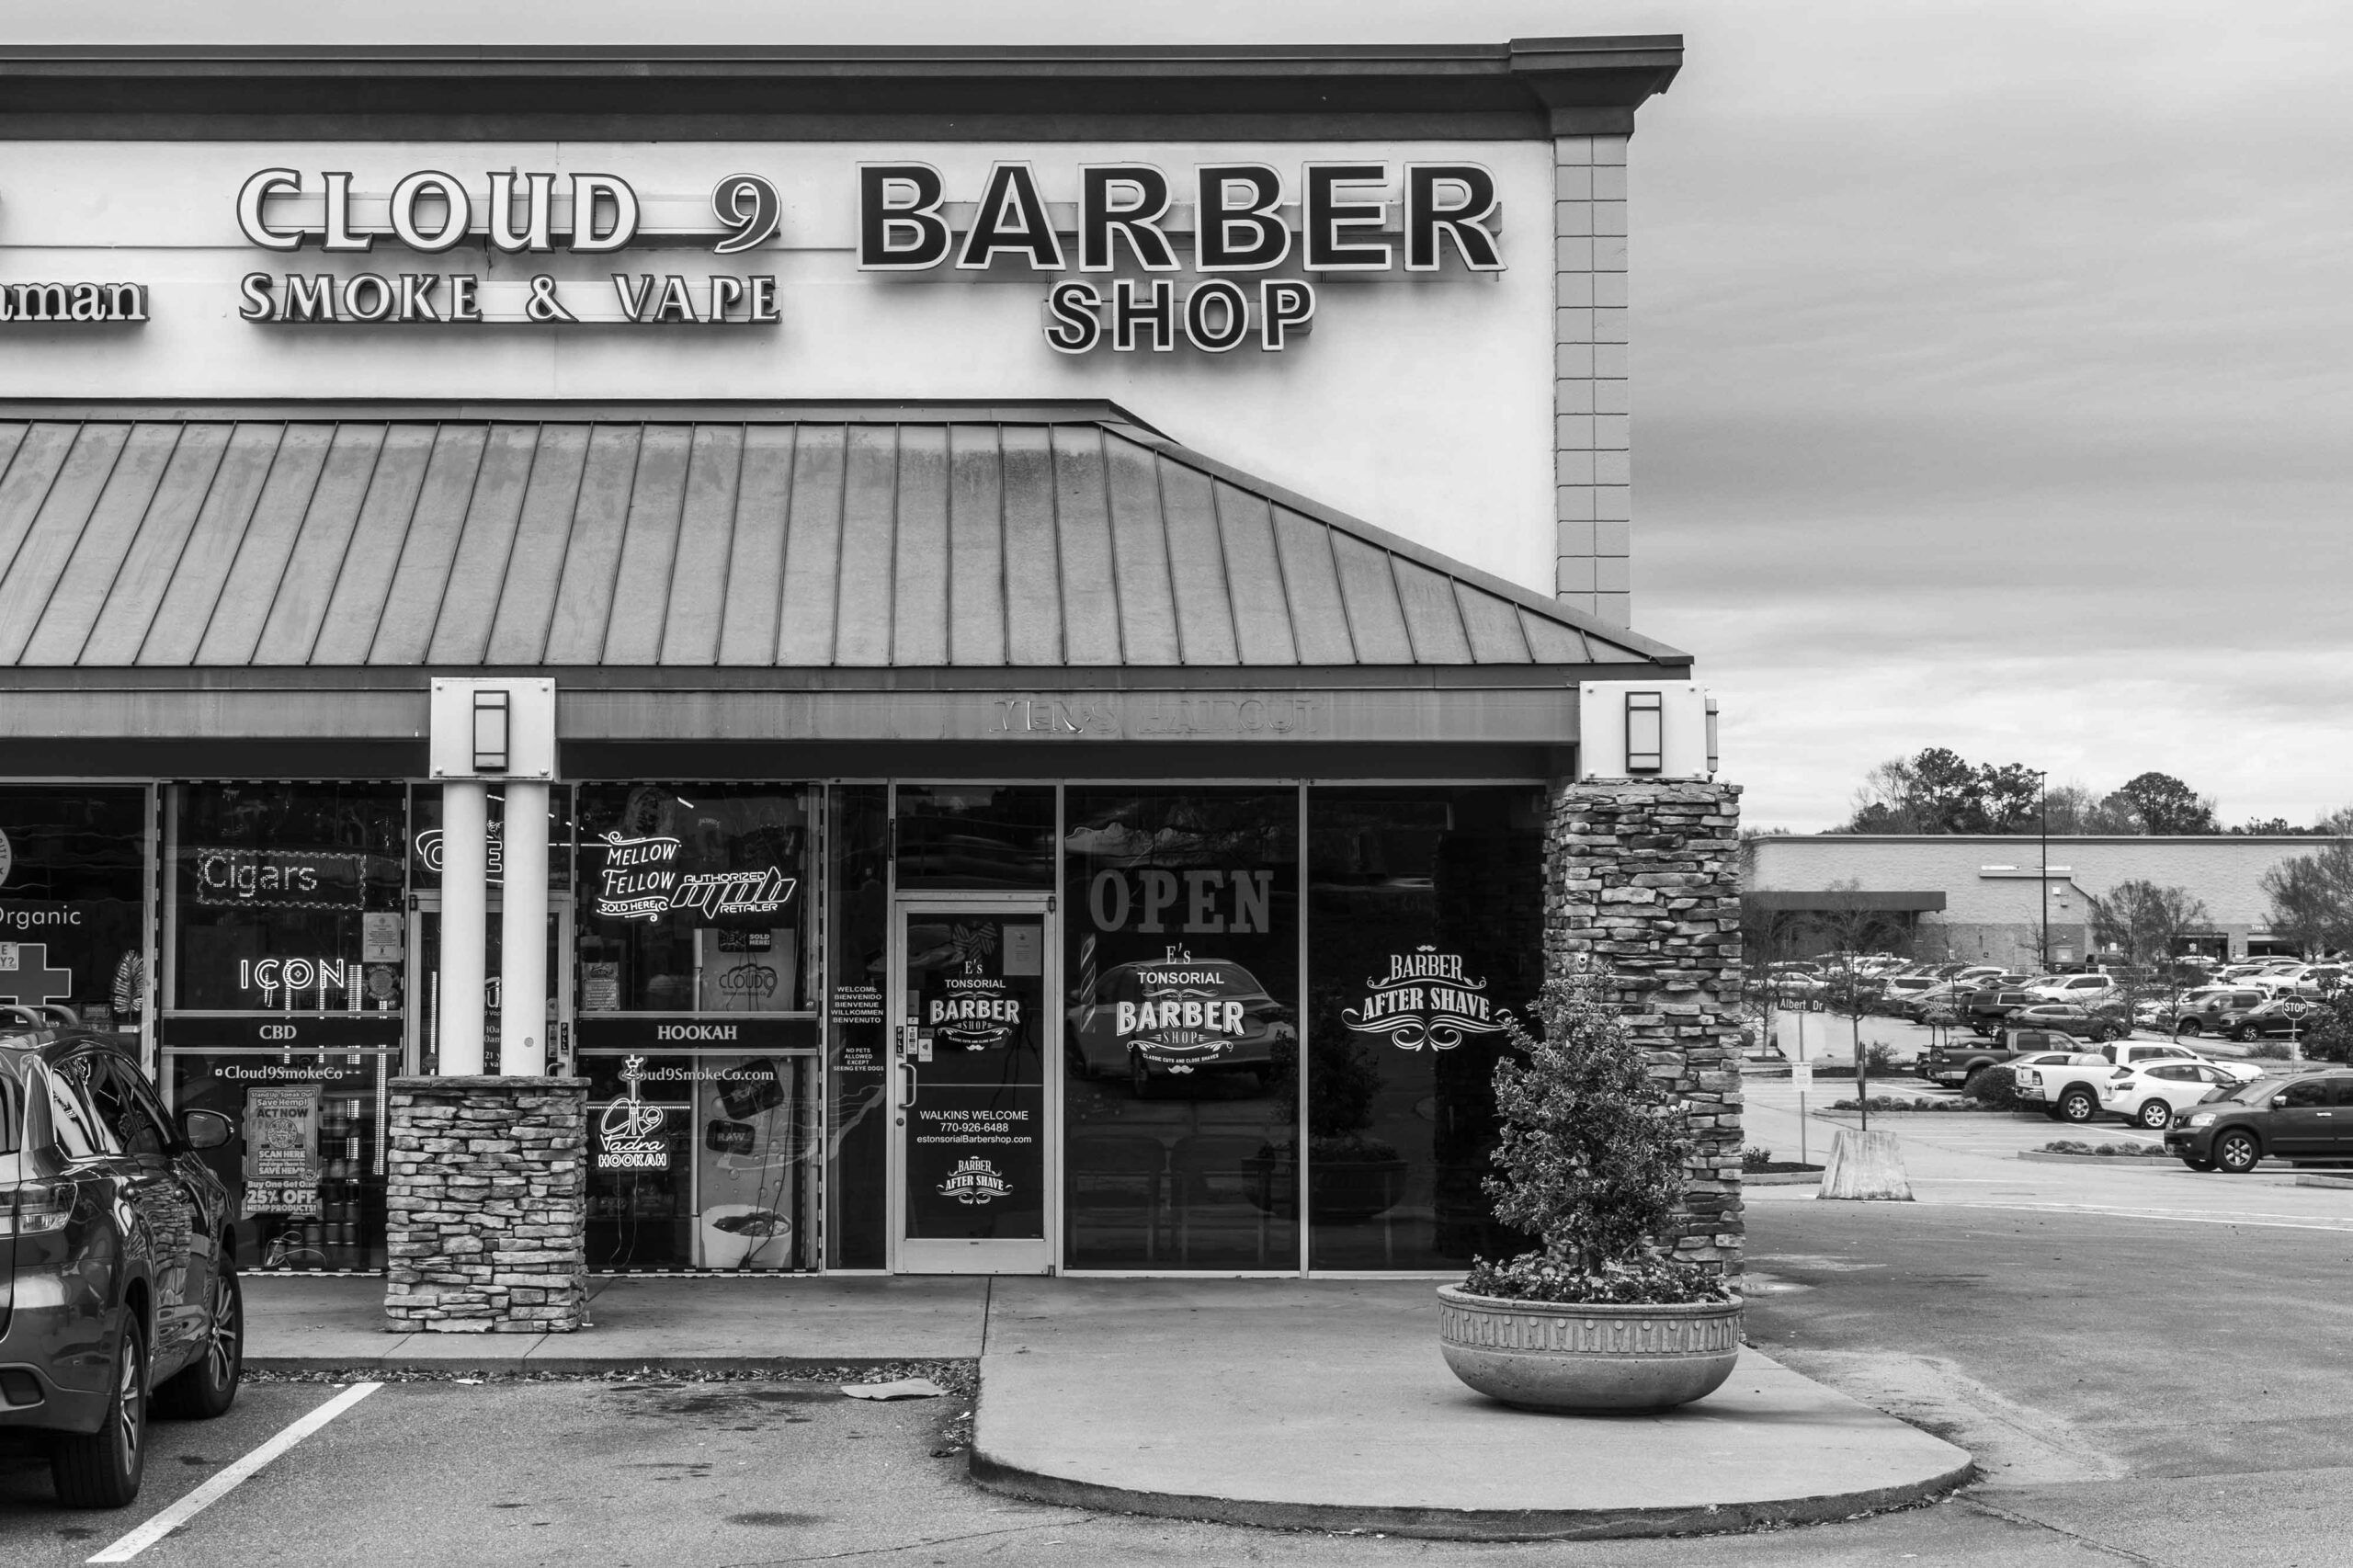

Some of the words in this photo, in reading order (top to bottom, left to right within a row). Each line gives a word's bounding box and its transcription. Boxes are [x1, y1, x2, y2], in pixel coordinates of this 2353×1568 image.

[236, 168, 640, 253] CLOUD
[710, 173, 781, 254] 9
[857, 160, 1507, 272] BARBER
[239, 272, 483, 323] SMOKE
[525, 275, 577, 323] &
[611, 275, 781, 324] VAPE
[1044, 279, 1315, 354] SHOP
[607, 844, 676, 866] MELLOW
[205, 856, 317, 898] Cigars
[602, 869, 676, 896] FELLOW
[684, 872, 767, 883] AUTHORIZED
[601, 902, 628, 913] SOLD
[631, 901, 655, 911] HERE
[721, 903, 778, 914] RETAILER
[1090, 869, 1274, 934] OPEN
[0, 904, 81, 929] rganic
[1166, 942, 1191, 964] E's
[240, 958, 345, 989] ICON
[965, 959, 983, 974] E's
[1391, 954, 1463, 981] BARBER
[945, 979, 1006, 988] TONSORIAL
[1137, 971, 1224, 984] TONSORIAL
[1362, 987, 1424, 1021] AFTER
[1430, 987, 1490, 1021] SHAVE
[1779, 998, 1806, 1010] Albert
[1813, 1000, 1824, 1011] Dr
[2284, 1002, 2306, 1012] STOP
[930, 1000, 1020, 1025] BARBER
[1117, 1001, 1245, 1037] BARBER
[259, 1025, 297, 1040] CBD
[657, 1025, 737, 1040] HOOKAH
[963, 1021, 986, 1029] SHOP
[1164, 1031, 1198, 1045] SHOP
[224, 1065, 343, 1079] Cloud9SmokeCo
[257, 1098, 278, 1107] Save
[278, 1098, 307, 1108] Hemp!
[256, 1108, 278, 1118] ACT
[279, 1108, 309, 1118] NOW
[920, 1110, 969, 1120] WALKINS
[972, 1110, 1029, 1120] WELCOME
[940, 1123, 1008, 1132] 770-926-6488
[916, 1135, 1031, 1144] estonsorialBarbershop.com
[258, 1150, 282, 1158] SCAN
[283, 1150, 306, 1158] HERE
[598, 1153, 666, 1167] HOOKAH
[958, 1160, 991, 1173] BARBER
[247, 1180, 264, 1189] Buy
[946, 1175, 974, 1191] AFTER
[976, 1176, 1004, 1191] SHAVE
[247, 1189, 278, 1204] 25%
[283, 1189, 316, 1204] OFF
